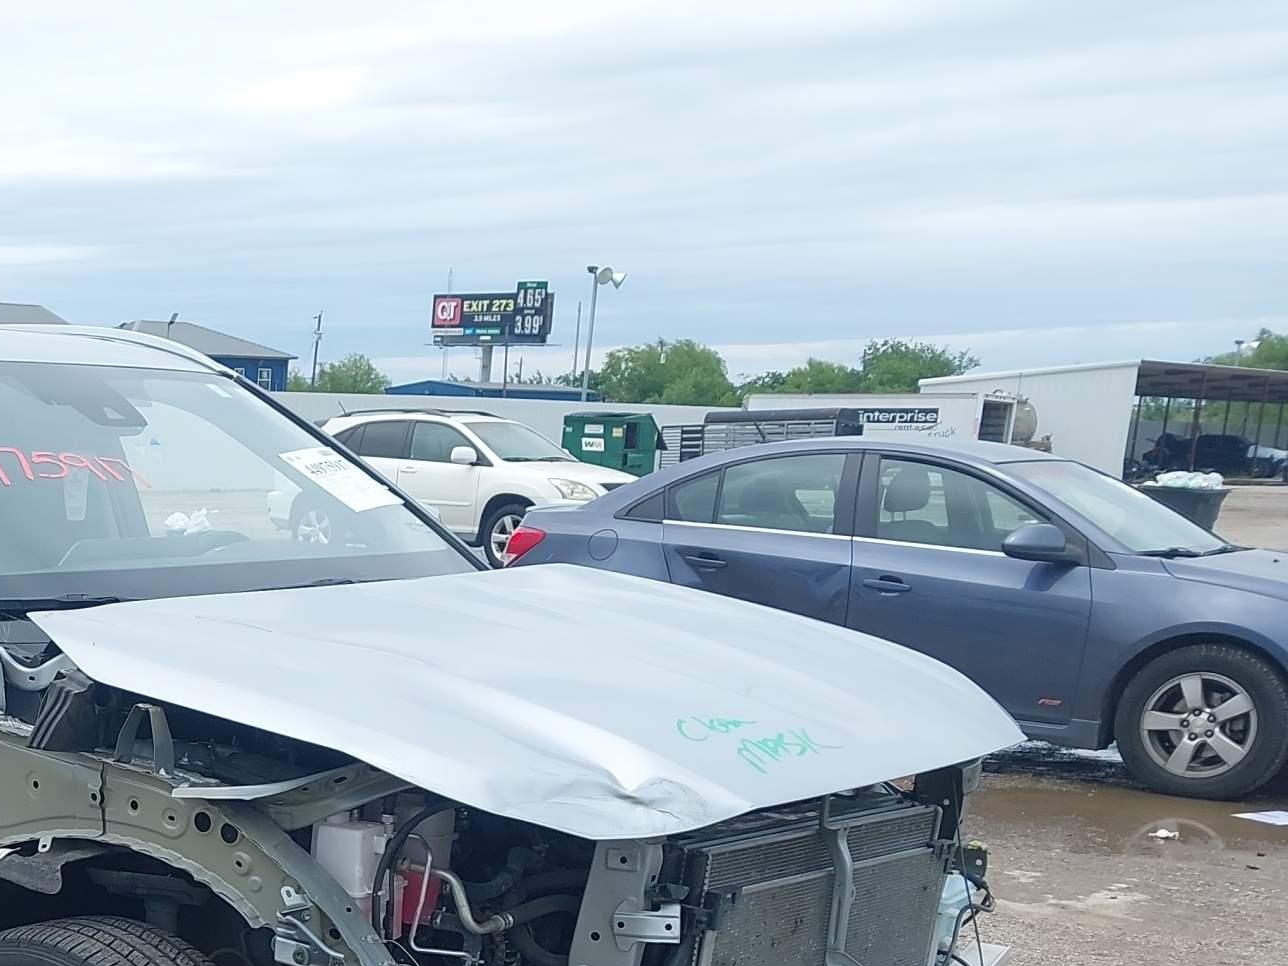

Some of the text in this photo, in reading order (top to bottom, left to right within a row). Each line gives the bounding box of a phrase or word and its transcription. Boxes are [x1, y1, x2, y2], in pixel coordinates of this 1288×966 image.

[463, 299, 514, 312] EXIT 273
[858, 409, 937, 423] nterprise
